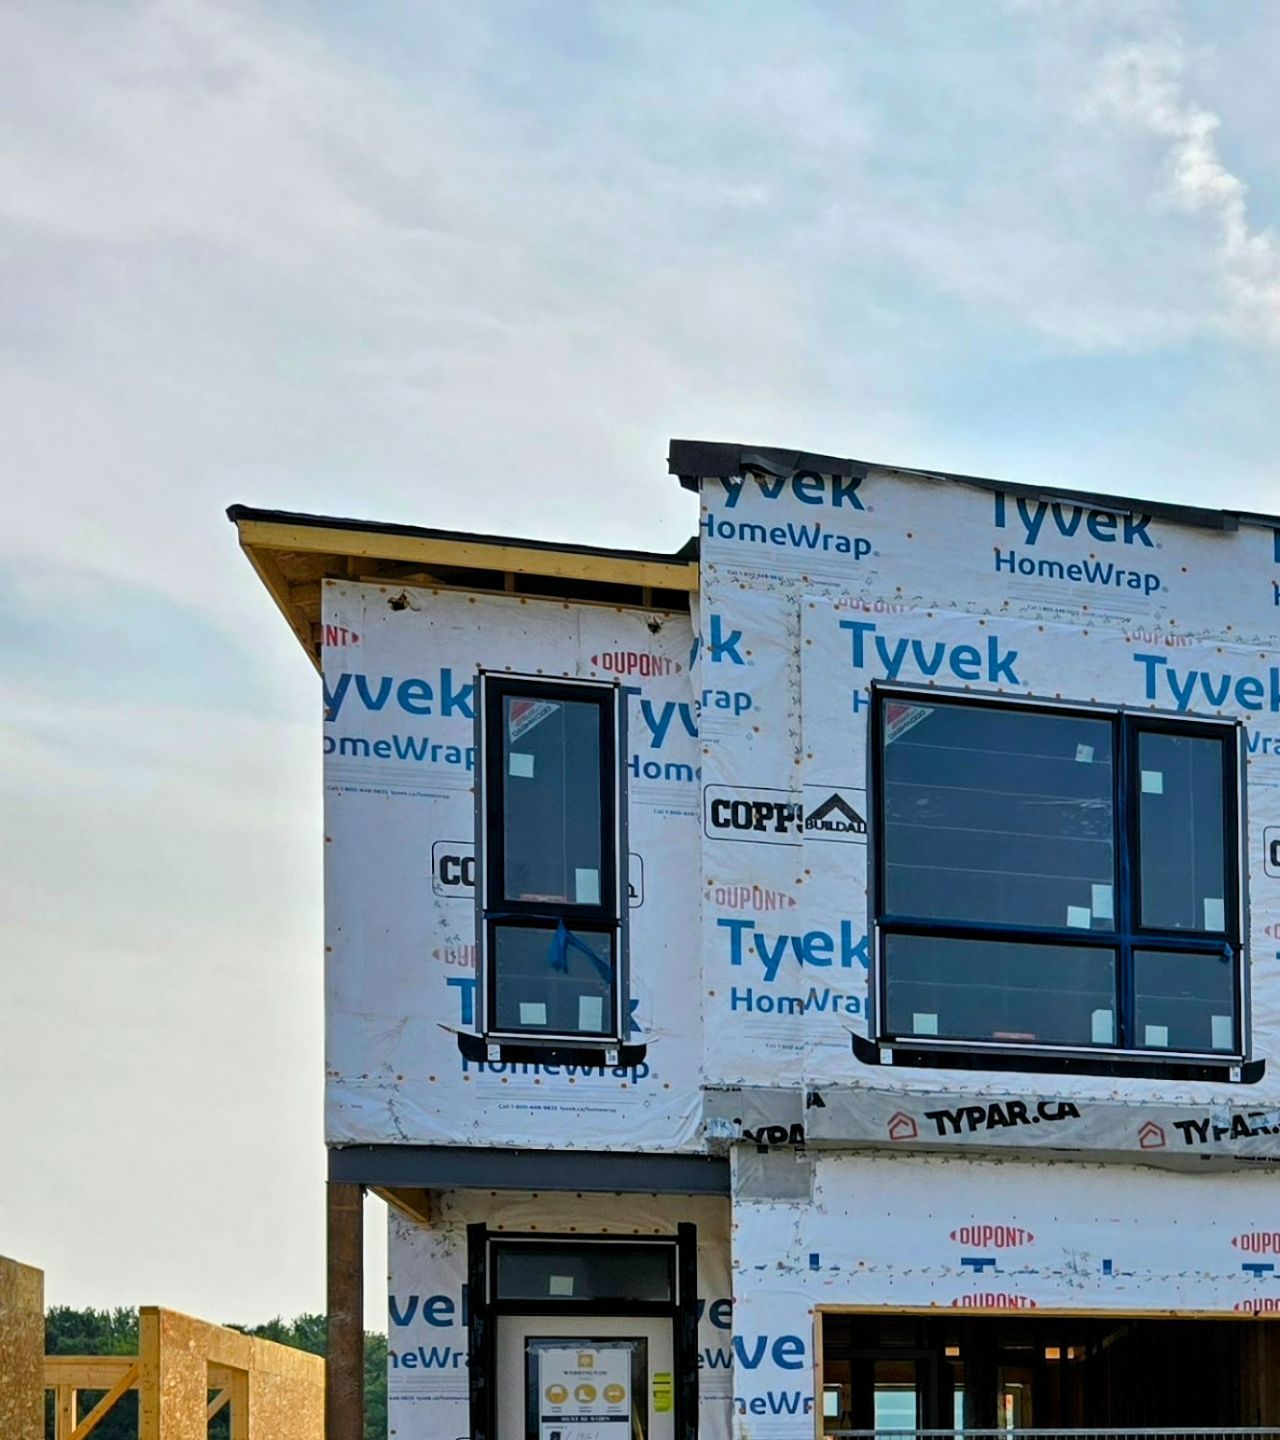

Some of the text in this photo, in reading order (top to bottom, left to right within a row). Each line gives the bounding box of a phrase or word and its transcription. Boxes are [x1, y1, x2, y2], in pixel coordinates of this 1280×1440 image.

[995, 550, 1160, 594] HomeWrap
[602, 651, 673, 676] DUPONT
[838, 618, 1019, 685] Tyvek
[716, 888, 786, 910] DUPONT
[926, 1101, 1081, 1135] TYPAR.CA
[960, 1226, 1024, 1248] DUPONT
